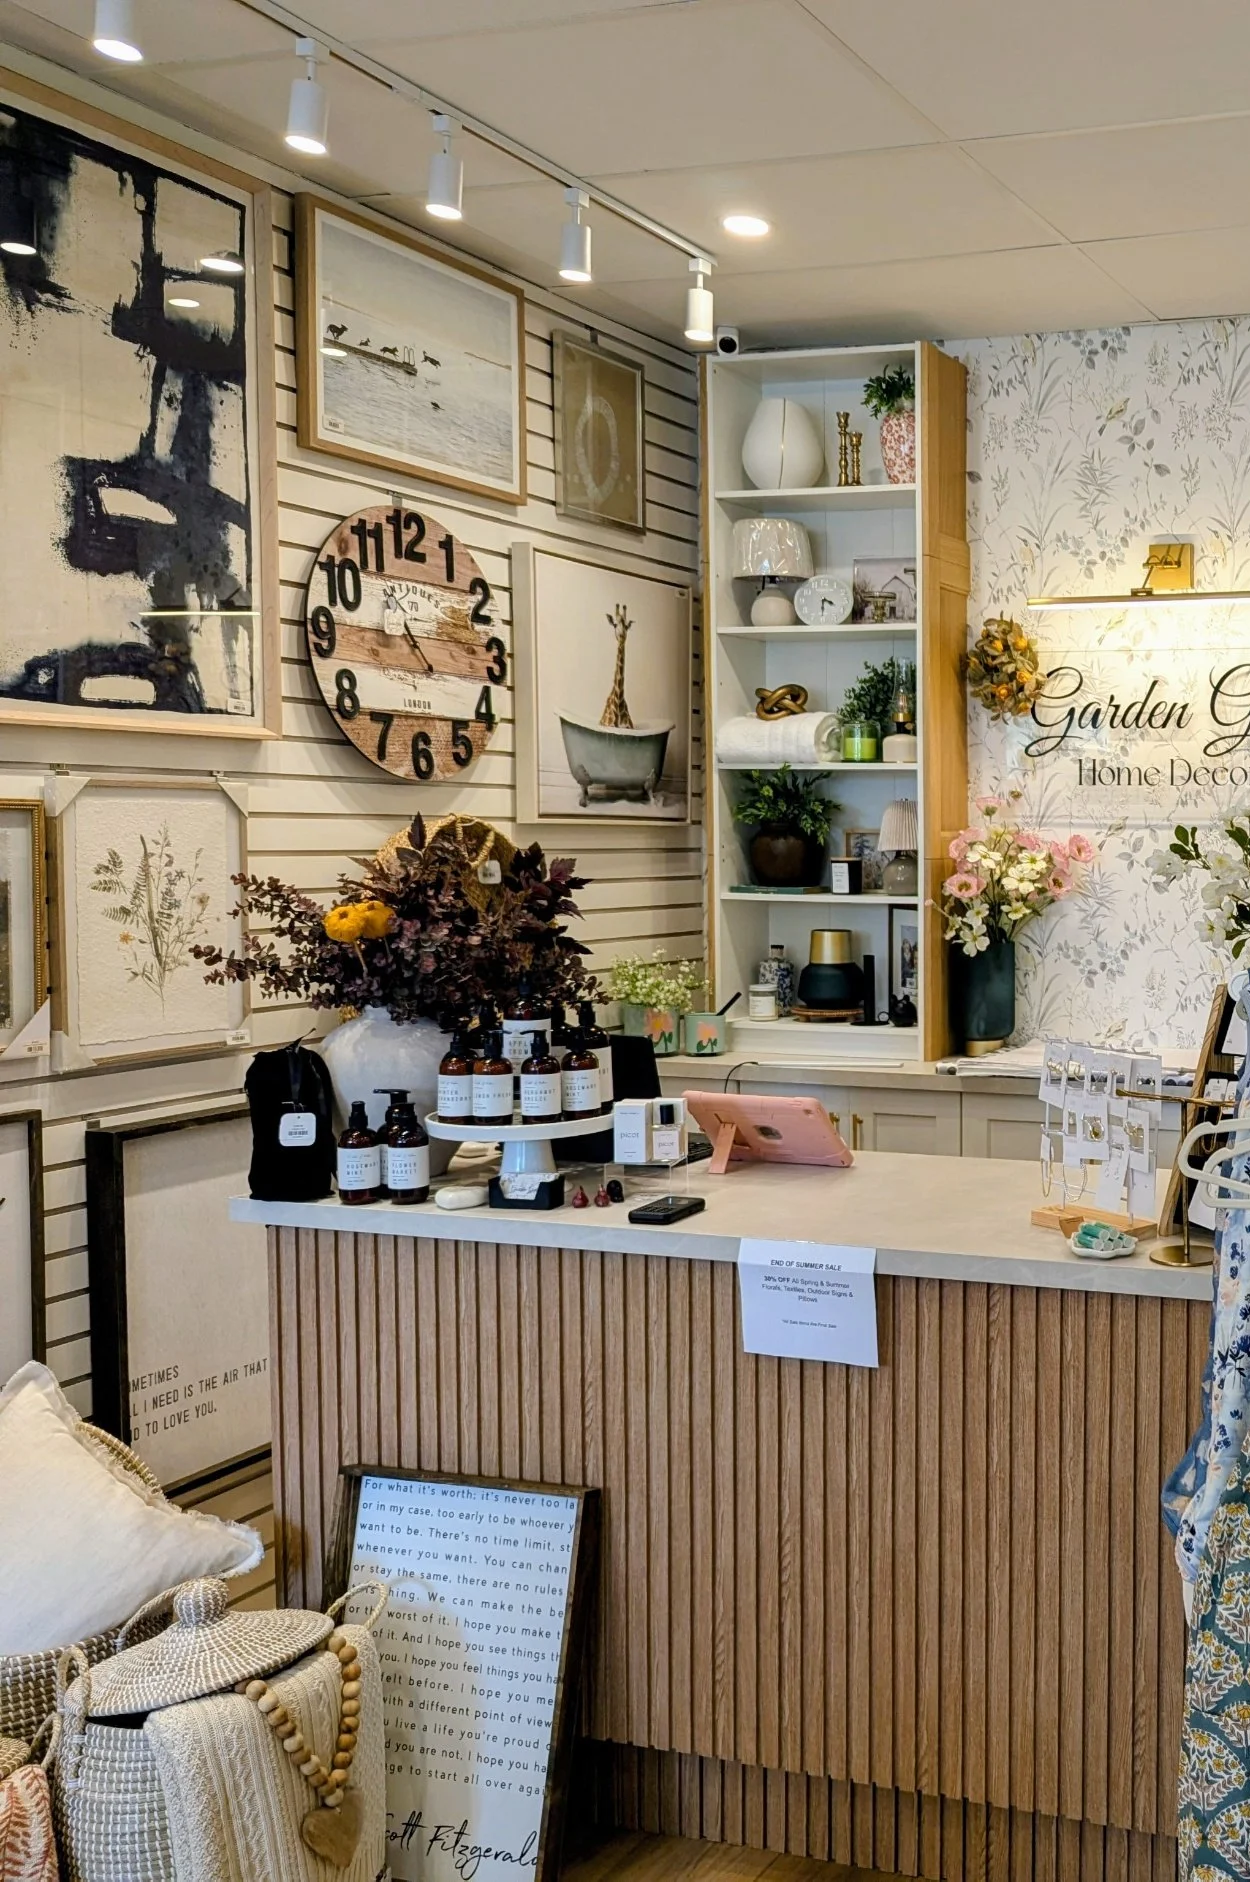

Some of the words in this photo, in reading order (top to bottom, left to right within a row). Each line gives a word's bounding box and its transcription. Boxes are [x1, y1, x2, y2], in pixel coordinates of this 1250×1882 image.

[351, 519, 384, 572] 11
[386, 509, 427, 563] 12
[439, 534, 454, 582] 1
[318, 555, 361, 611] 10
[383, 584, 440, 609] ANTIQUES
[469, 578, 492, 624] 2
[312, 606, 336, 657] 9
[486, 637, 507, 684] 3
[335, 669, 360, 719] 8
[404, 698, 431, 709] LONDON
[475, 686, 495, 731] 4
[1025, 667, 1192, 757] Garden
[370, 713, 394, 760] 7
[452, 721, 473, 766] 5
[412, 732, 435, 779] 6
[1078, 759, 1160, 786] Home
[796, 1262, 824, 1270] SUMMER
[801, 1279, 818, 1287] Spring
[832, 1289, 847, 1297] Signs
[130, 1365, 179, 1392] METIMES
[144, 1400, 147, 1412] I
[152, 1389, 179, 1410] NEED
[184, 1385, 193, 1399] IS
[199, 1376, 218, 1393] THE
[223, 1368, 238, 1385] AIR
[244, 1358, 268, 1378] THAT
[146, 1421, 158, 1436] TO
[164, 1409, 189, 1430] LOVE
[195, 1400, 217, 1419] YOU.
[365, 1479, 382, 1489] For
[388, 1481, 413, 1494] what
[418, 1485, 435, 1496] it's
[441, 1489, 476, 1501] worth:
[481, 1491, 499, 1502] it's
[505, 1494, 535, 1505] never
[541, 1497, 559, 1509] too
[566, 1499, 575, 1510] la
[363, 1501, 374, 1509] or
[377, 1500, 385, 1511] in
[390, 1504, 404, 1515] my
[408, 1507, 433, 1518] case,
[438, 1508, 454, 1518] too
[459, 1510, 483, 1524] early
[489, 1513, 499, 1523] to
[503, 1514, 515, 1525] be
[520, 1517, 564, 1530] whoever
[360, 1522, 385, 1532] want
[391, 1524, 401, 1533] to
[407, 1525, 423, 1536] be.
[429, 1528, 469, 1541] There's
[475, 1534, 488, 1543] no
[494, 1535, 518, 1547] time
[524, 1537, 554, 1551] limit,
[357, 1542, 412, 1557] whenever
[417, 1550, 438, 1560] you
[445, 1552, 477, 1564] want.
[484, 1555, 505, 1568] You
[512, 1561, 532, 1571] can
[539, 1562, 567, 1574] chan
[354, 1562, 365, 1571] or
[370, 1563, 392, 1578] stay
[397, 1567, 415, 1578] the
[420, 1570, 451, 1583] same,
[457, 1574, 486, 1586] there
[492, 1579, 509, 1590] are
[515, 1583, 529, 1592] no
[535, 1583, 563, 1595] rules
[428, 1592, 445, 1603] We
[453, 1596, 473, 1607] can
[481, 1599, 513, 1612] make
[522, 1602, 541, 1615] the
[387, 1609, 417, 1622] worst
[423, 1614, 433, 1623] of
[438, 1615, 449, 1626] it.
[455, 1617, 458, 1626] I
[463, 1618, 491, 1632] hope
[496, 1624, 515, 1635] you
[522, 1627, 551, 1639] make
[409, 1676, 454, 1693] before.
[419, 1701, 469, 1717] different
[475, 1709, 504, 1723] point
[460, 1728, 498, 1743] you're
[504, 1735, 539, 1750] proud
[428, 1768, 457, 1782] start
[464, 1774, 479, 1785] all
[485, 1779, 512, 1791] over
[386, 1811, 425, 1851] cott
